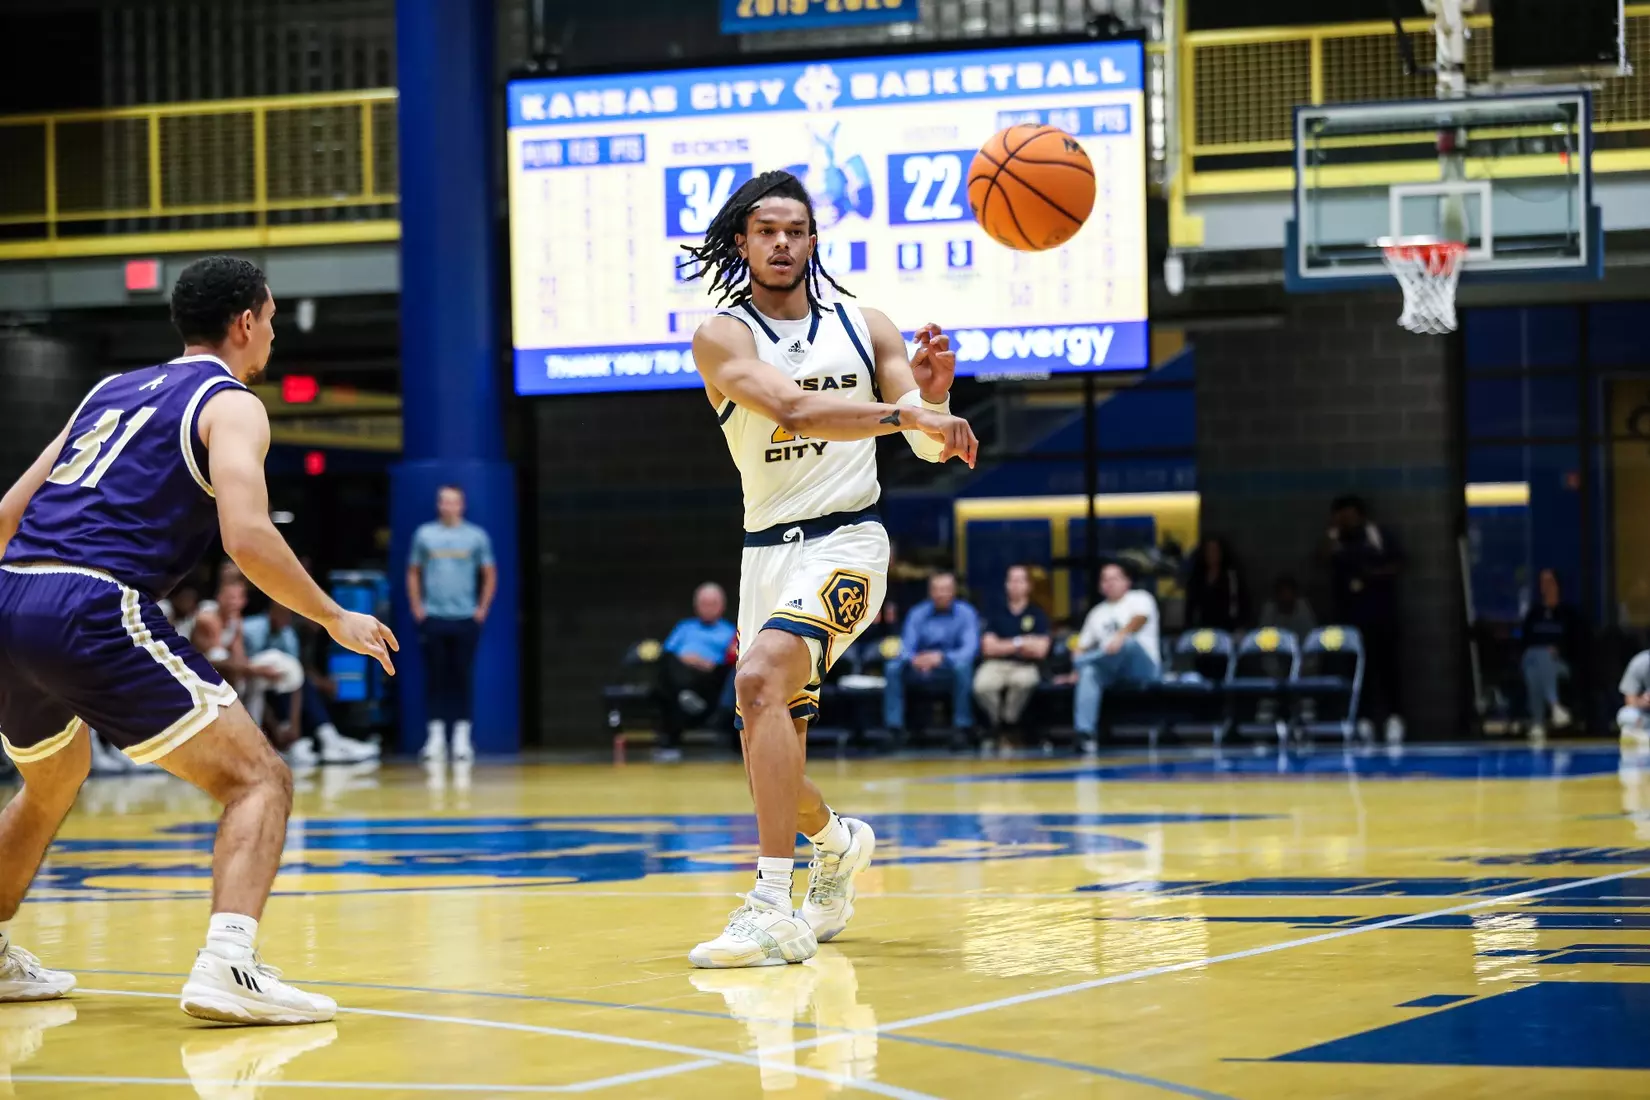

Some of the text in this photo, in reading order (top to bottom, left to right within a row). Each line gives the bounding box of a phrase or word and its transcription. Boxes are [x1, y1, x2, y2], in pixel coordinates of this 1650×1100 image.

[521, 86, 677, 120] KANSAS
[691, 79, 784, 110] CITY
[851, 58, 1126, 99] BASKETBALL
[903, 154, 964, 221] 22
[990, 325, 1115, 367] evergy
[795, 373, 857, 391] SAS
[46, 406, 158, 488] 31
[764, 440, 829, 463] CITY
